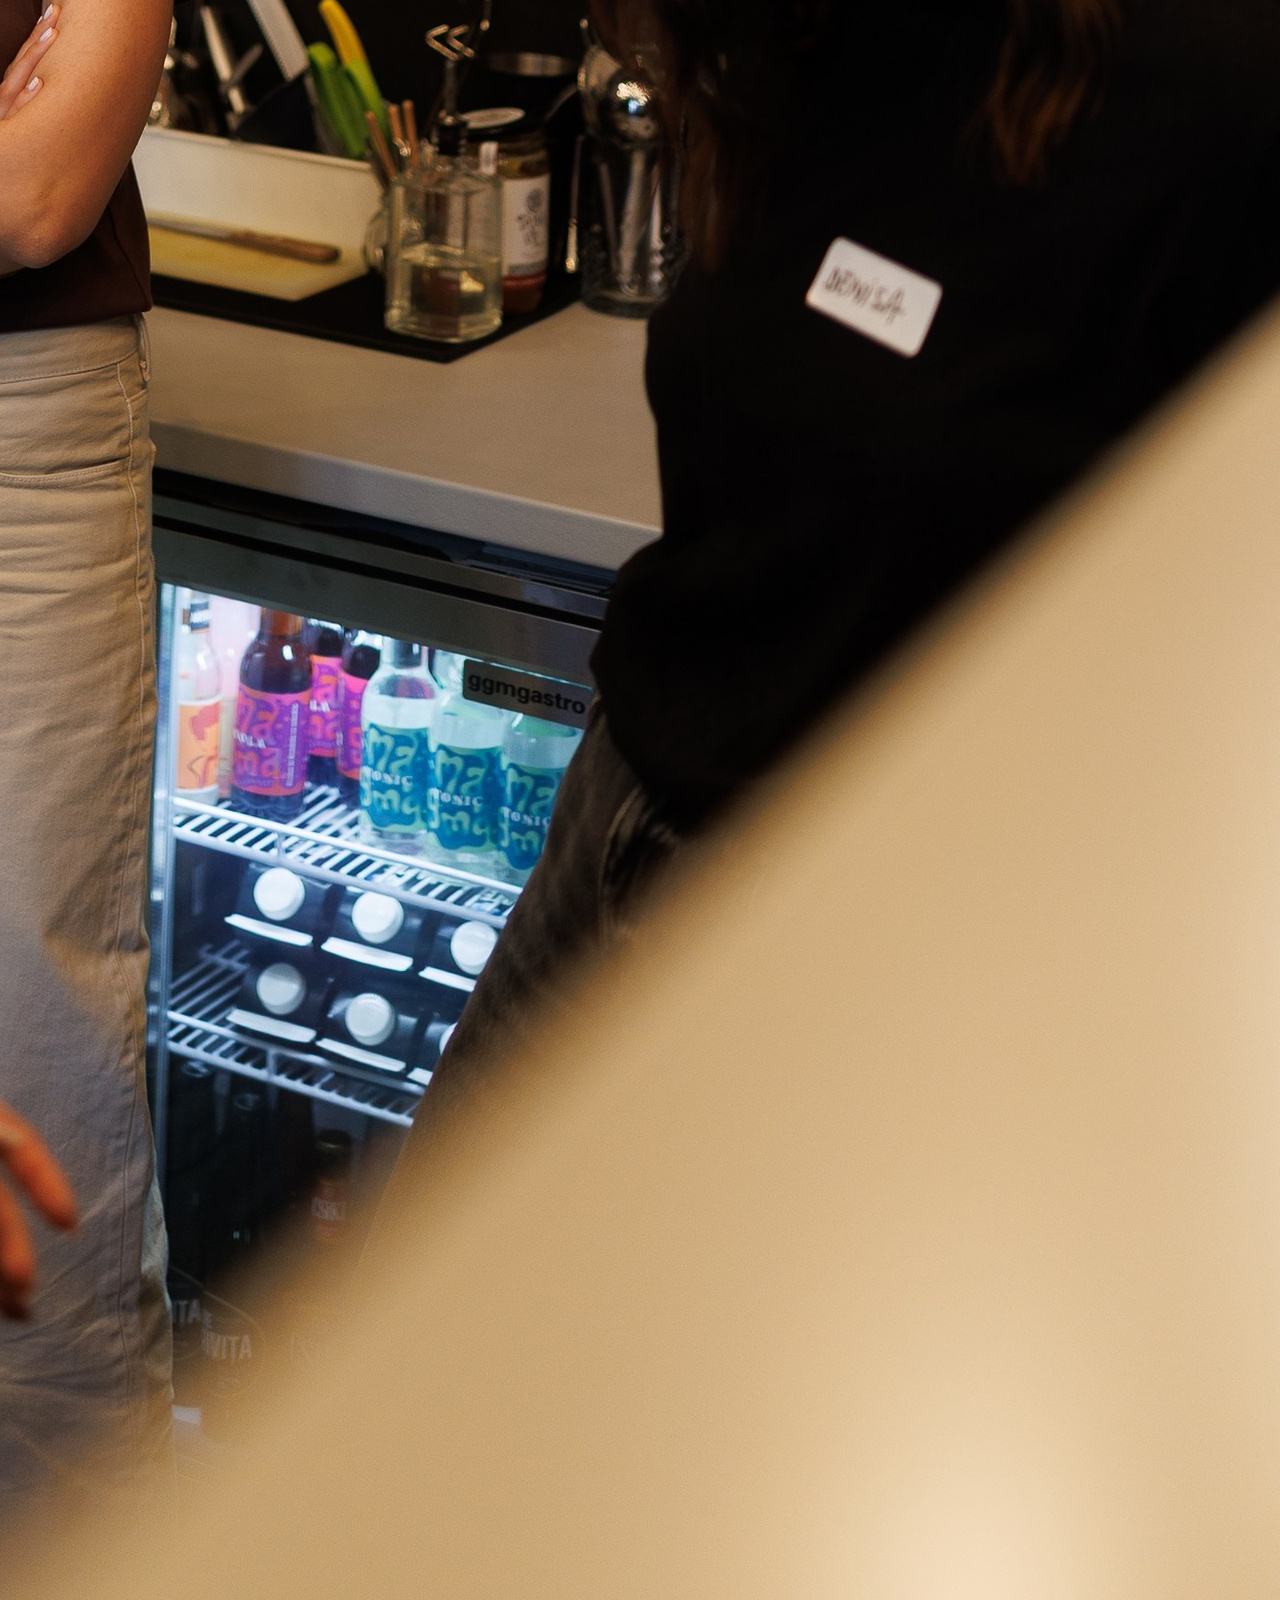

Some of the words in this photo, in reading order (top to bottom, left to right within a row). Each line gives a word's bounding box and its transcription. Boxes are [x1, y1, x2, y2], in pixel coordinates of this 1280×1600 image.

[467, 672, 587, 716] ggmgastro
[362, 766, 413, 787] TONIC
[429, 786, 484, 808] TONIC
